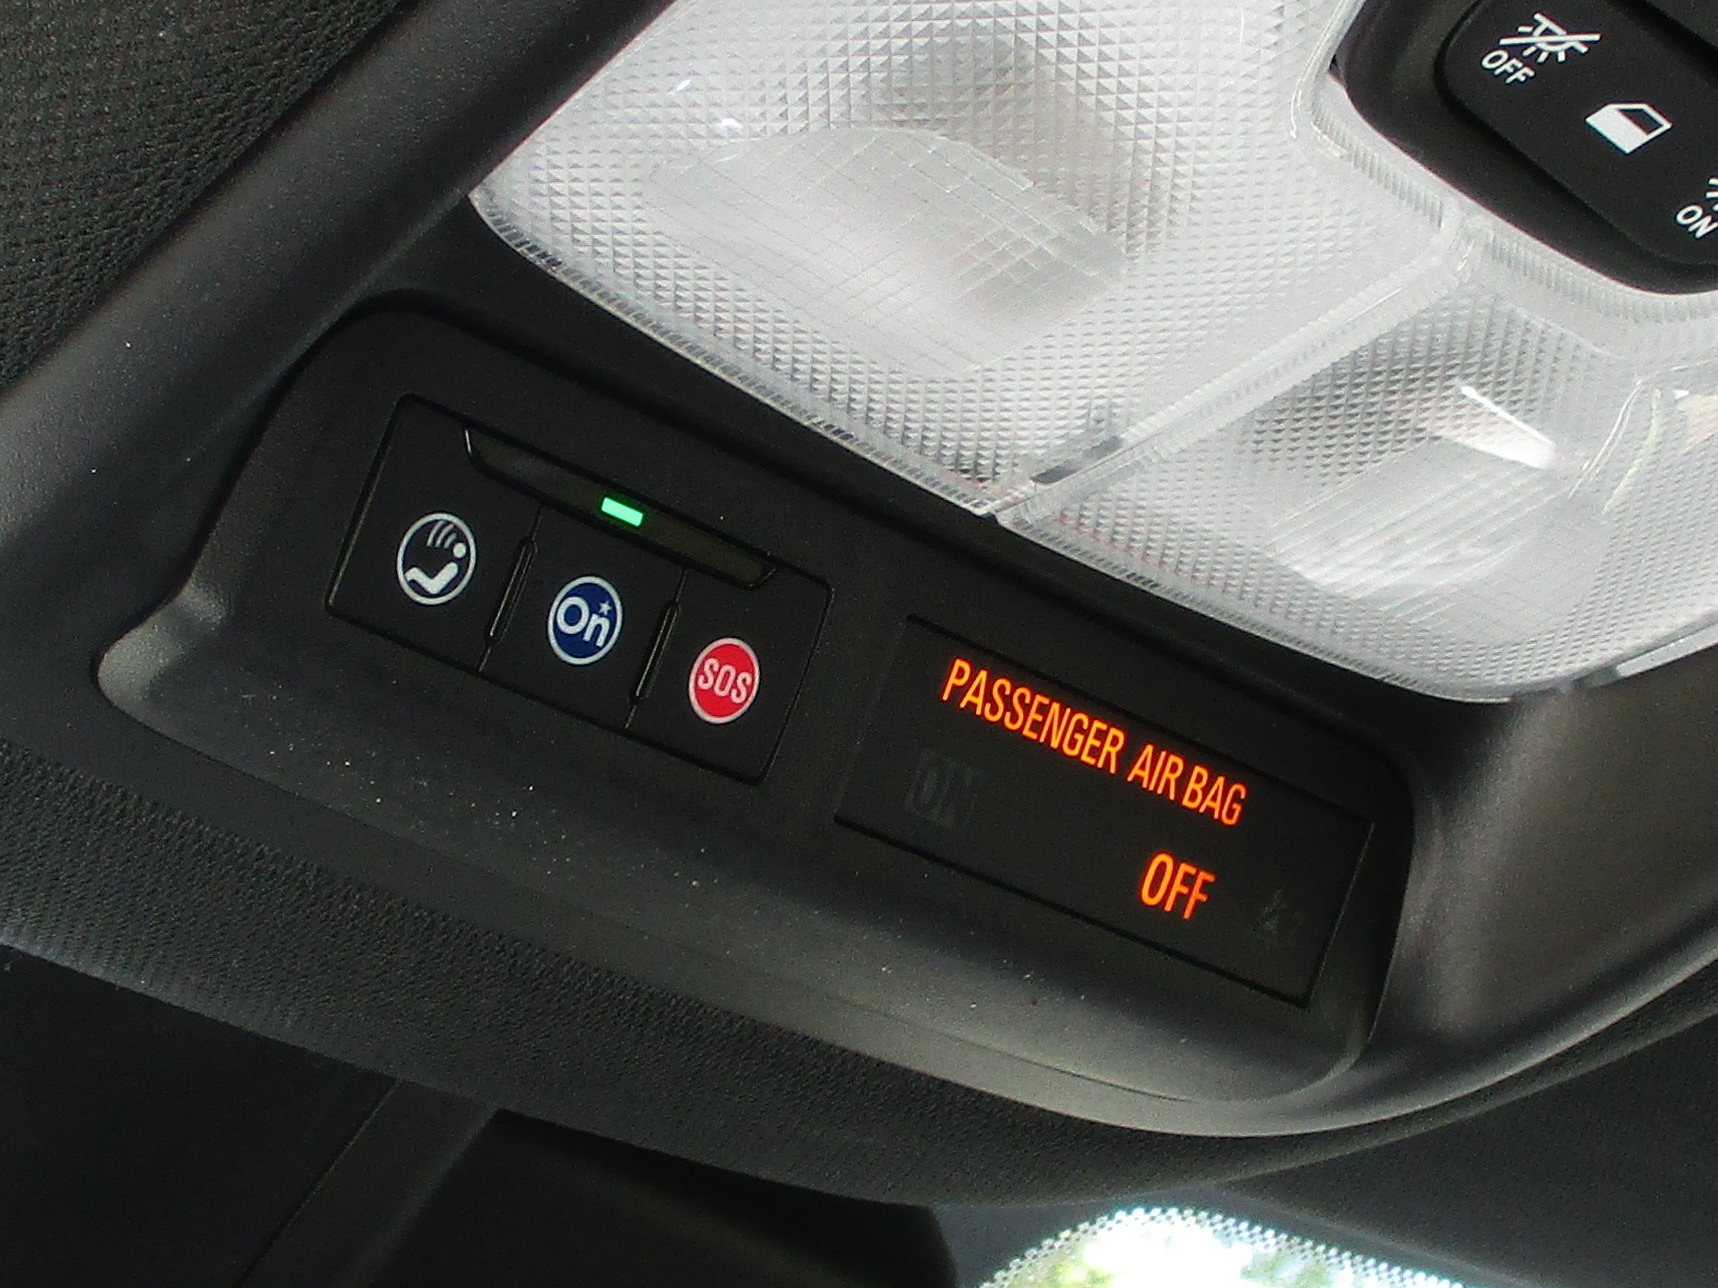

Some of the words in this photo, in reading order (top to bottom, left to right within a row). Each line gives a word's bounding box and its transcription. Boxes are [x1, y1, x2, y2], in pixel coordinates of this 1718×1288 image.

[1481, 49, 1535, 85] OFF
[1676, 205, 1718, 239] ON
[556, 596, 611, 648] On
[697, 657, 753, 705] SOS
[939, 657, 1126, 775] PASSENGER
[1126, 743, 1184, 801] AIR
[1181, 764, 1248, 827] BAG
[1138, 850, 1217, 920] OFF
